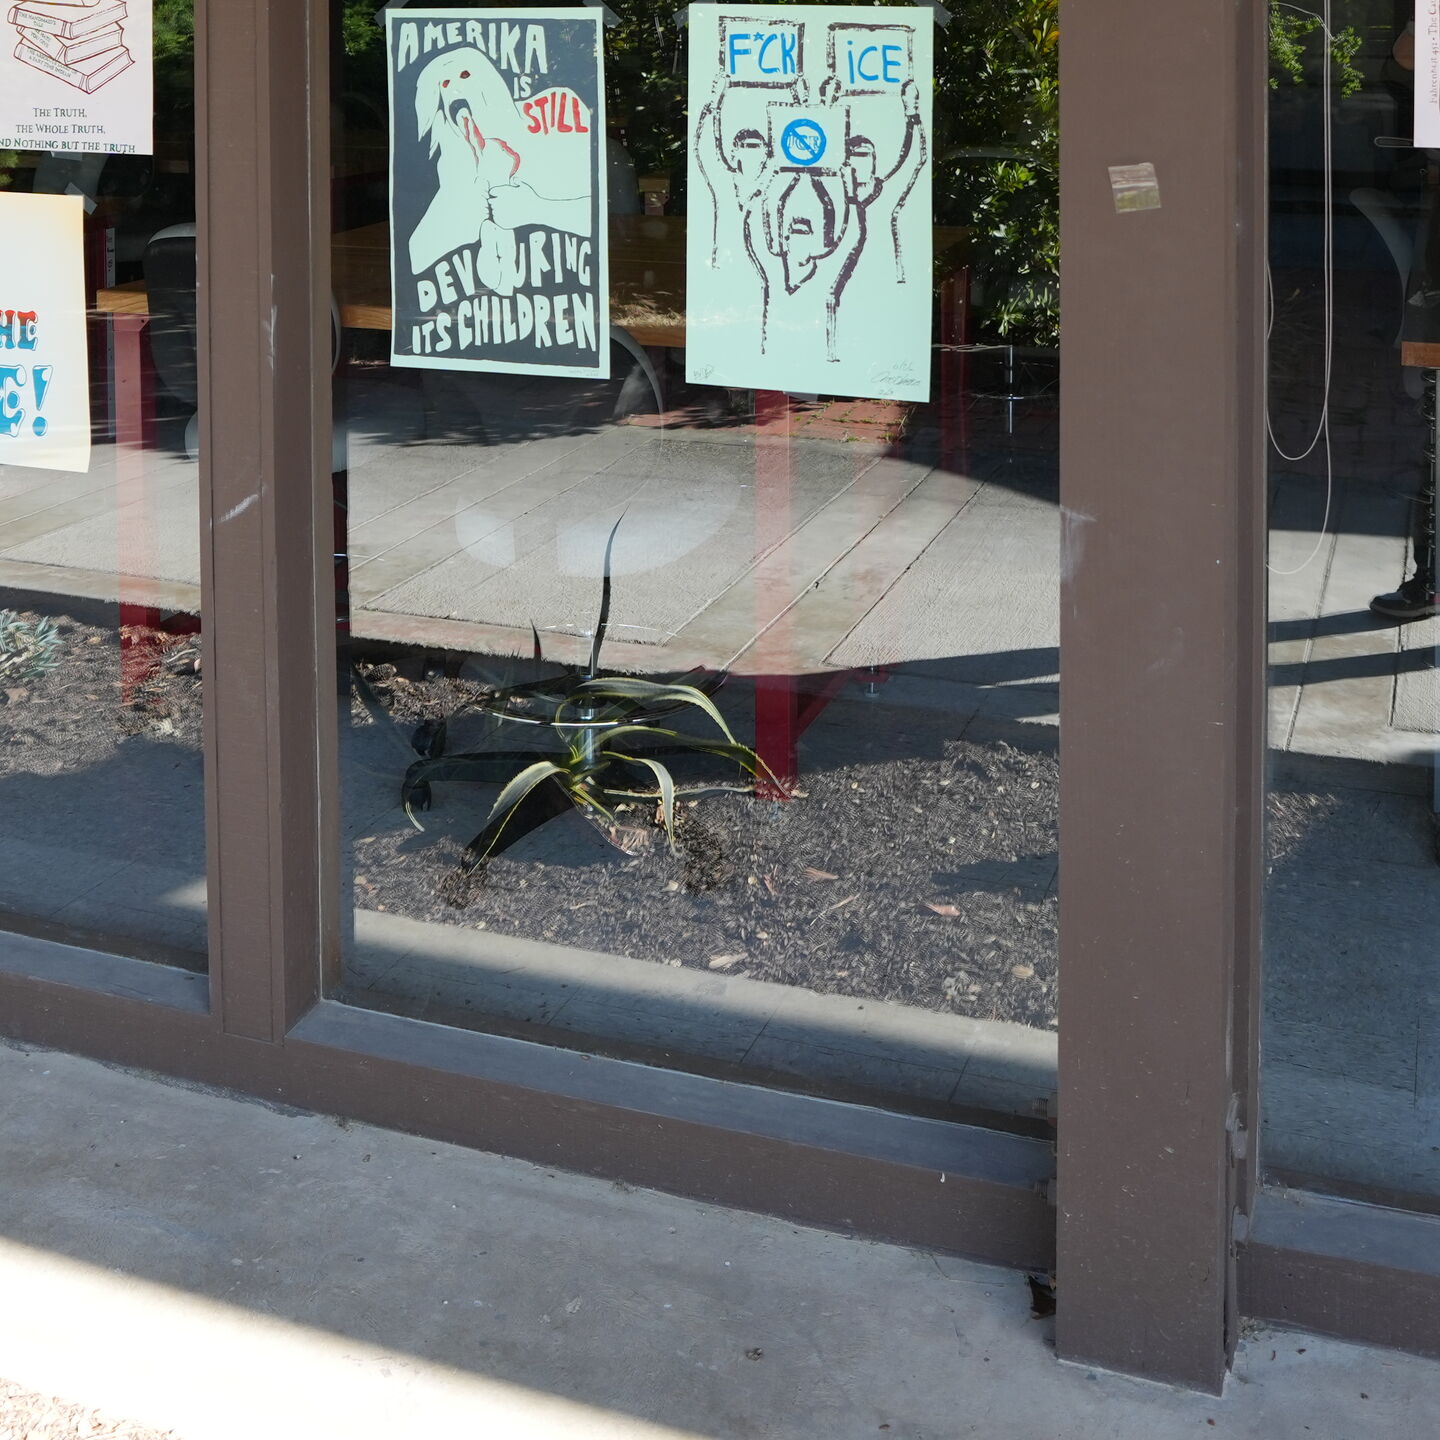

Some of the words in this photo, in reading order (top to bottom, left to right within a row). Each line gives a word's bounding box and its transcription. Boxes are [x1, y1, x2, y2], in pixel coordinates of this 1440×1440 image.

[396, 21, 548, 74] AMERIKA
[512, 75, 532, 100] IS
[33, 107, 52, 117] THE
[522, 90, 590, 136] STILL
[16, 124, 33, 134] THE
[35, 123, 69, 134] WHOLE
[71, 124, 106, 135] TRUTH,
[13, 137, 59, 149] NOTHING
[61, 140, 80, 150] BUT
[81, 141, 100, 151] THE
[102, 143, 136, 154] TRUTH
[411, 311, 452, 354] ITS
[456, 292, 598, 353] CHILDREN
